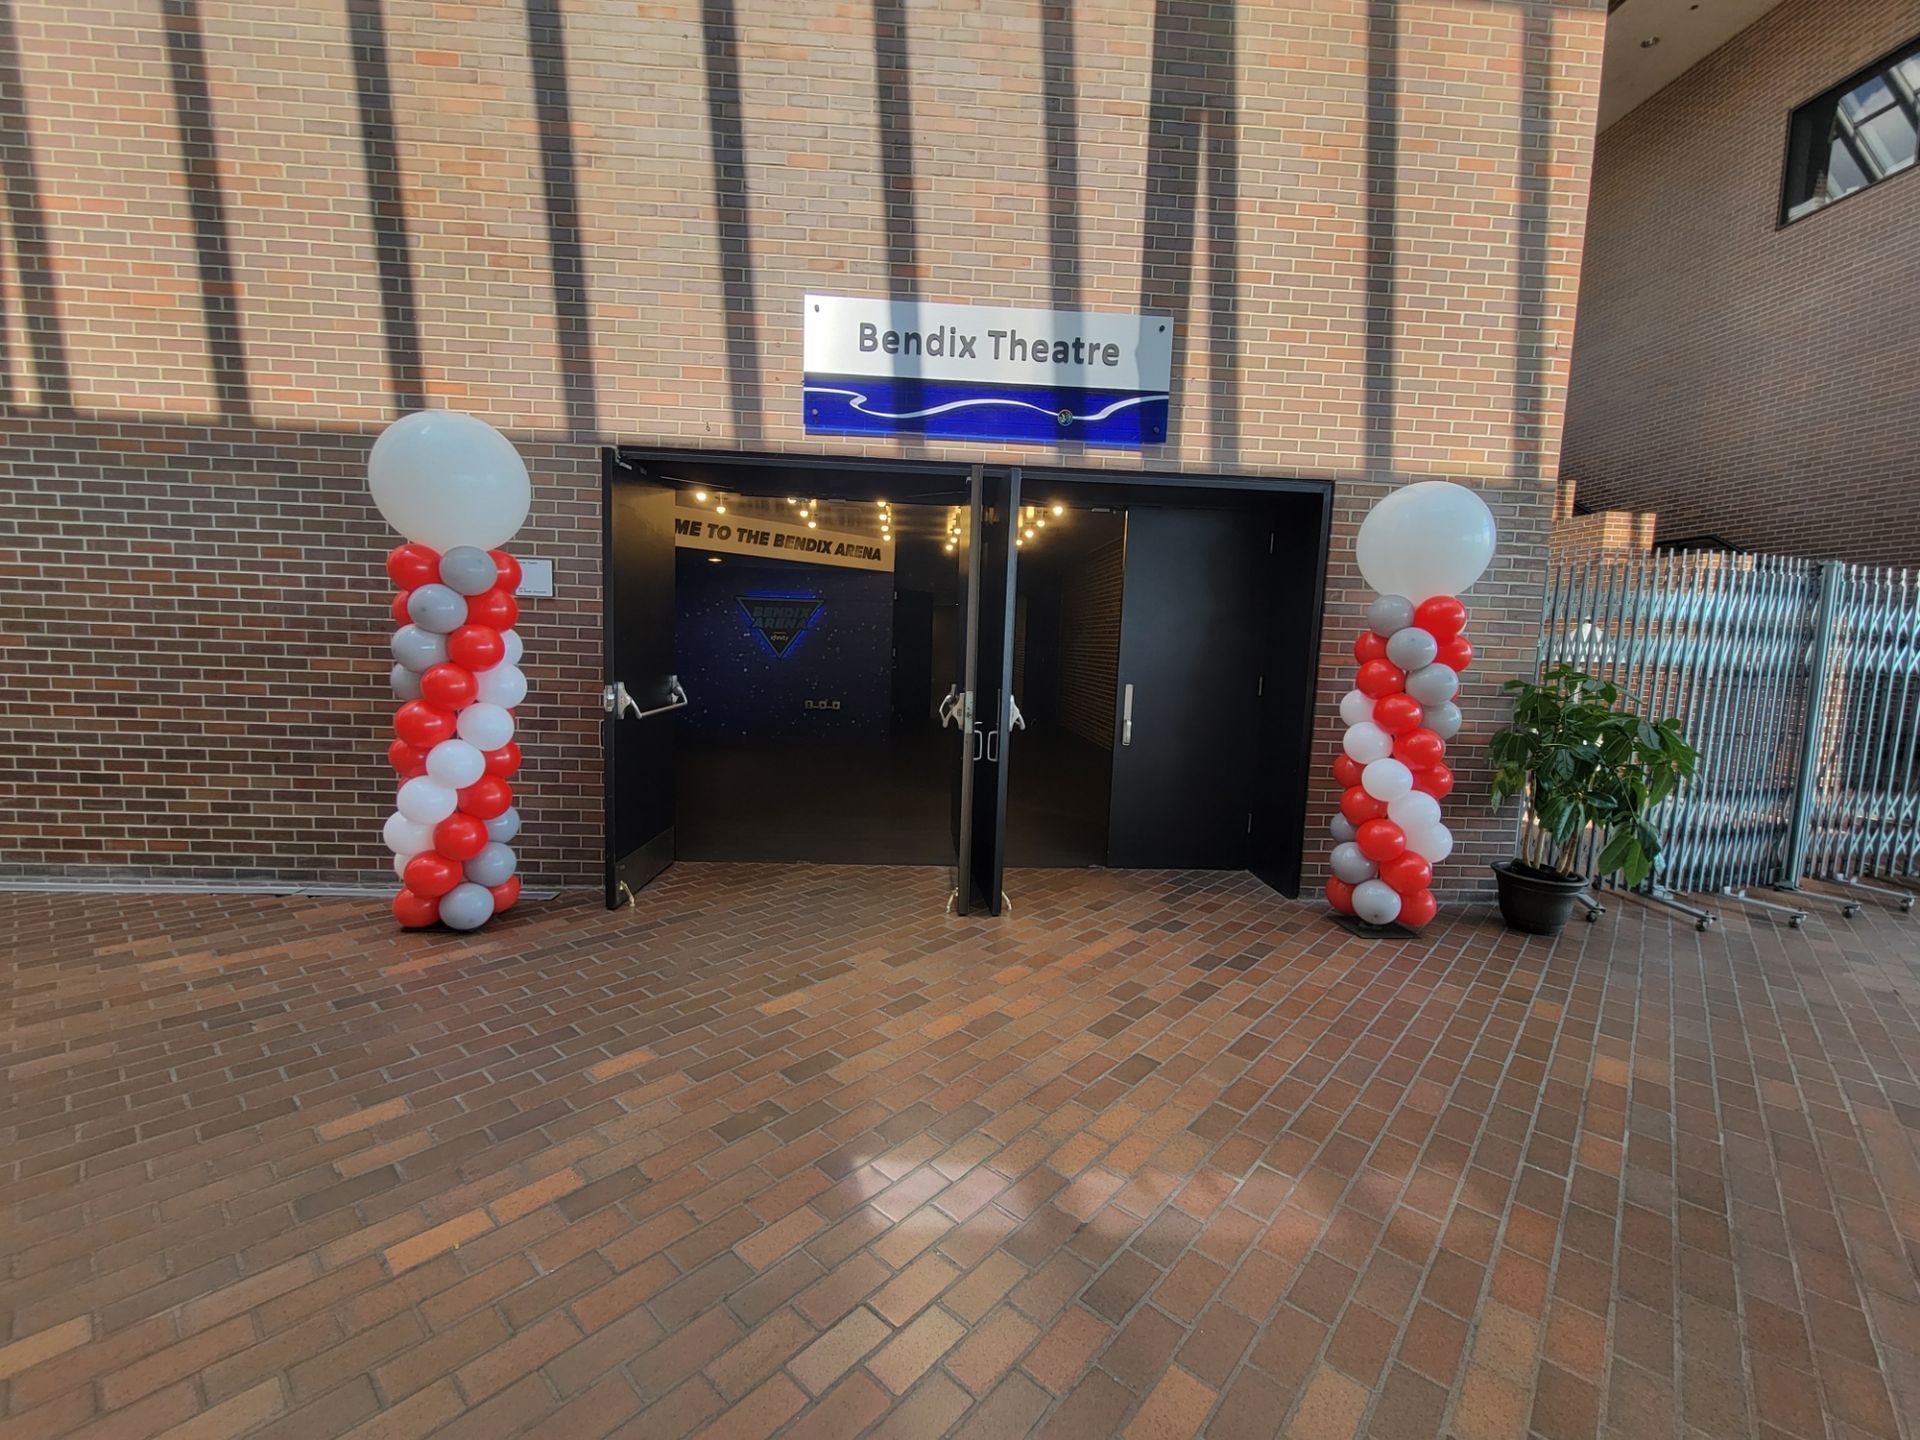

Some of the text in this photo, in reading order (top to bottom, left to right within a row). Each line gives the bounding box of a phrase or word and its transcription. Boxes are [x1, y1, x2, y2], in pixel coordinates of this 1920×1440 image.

[859, 322, 1120, 366] Bendix Theatre
[675, 518, 881, 561] ME TO THE BENDIX ARENA
[752, 618, 807, 628] ARENA
[753, 606, 811, 617] BENDIX
